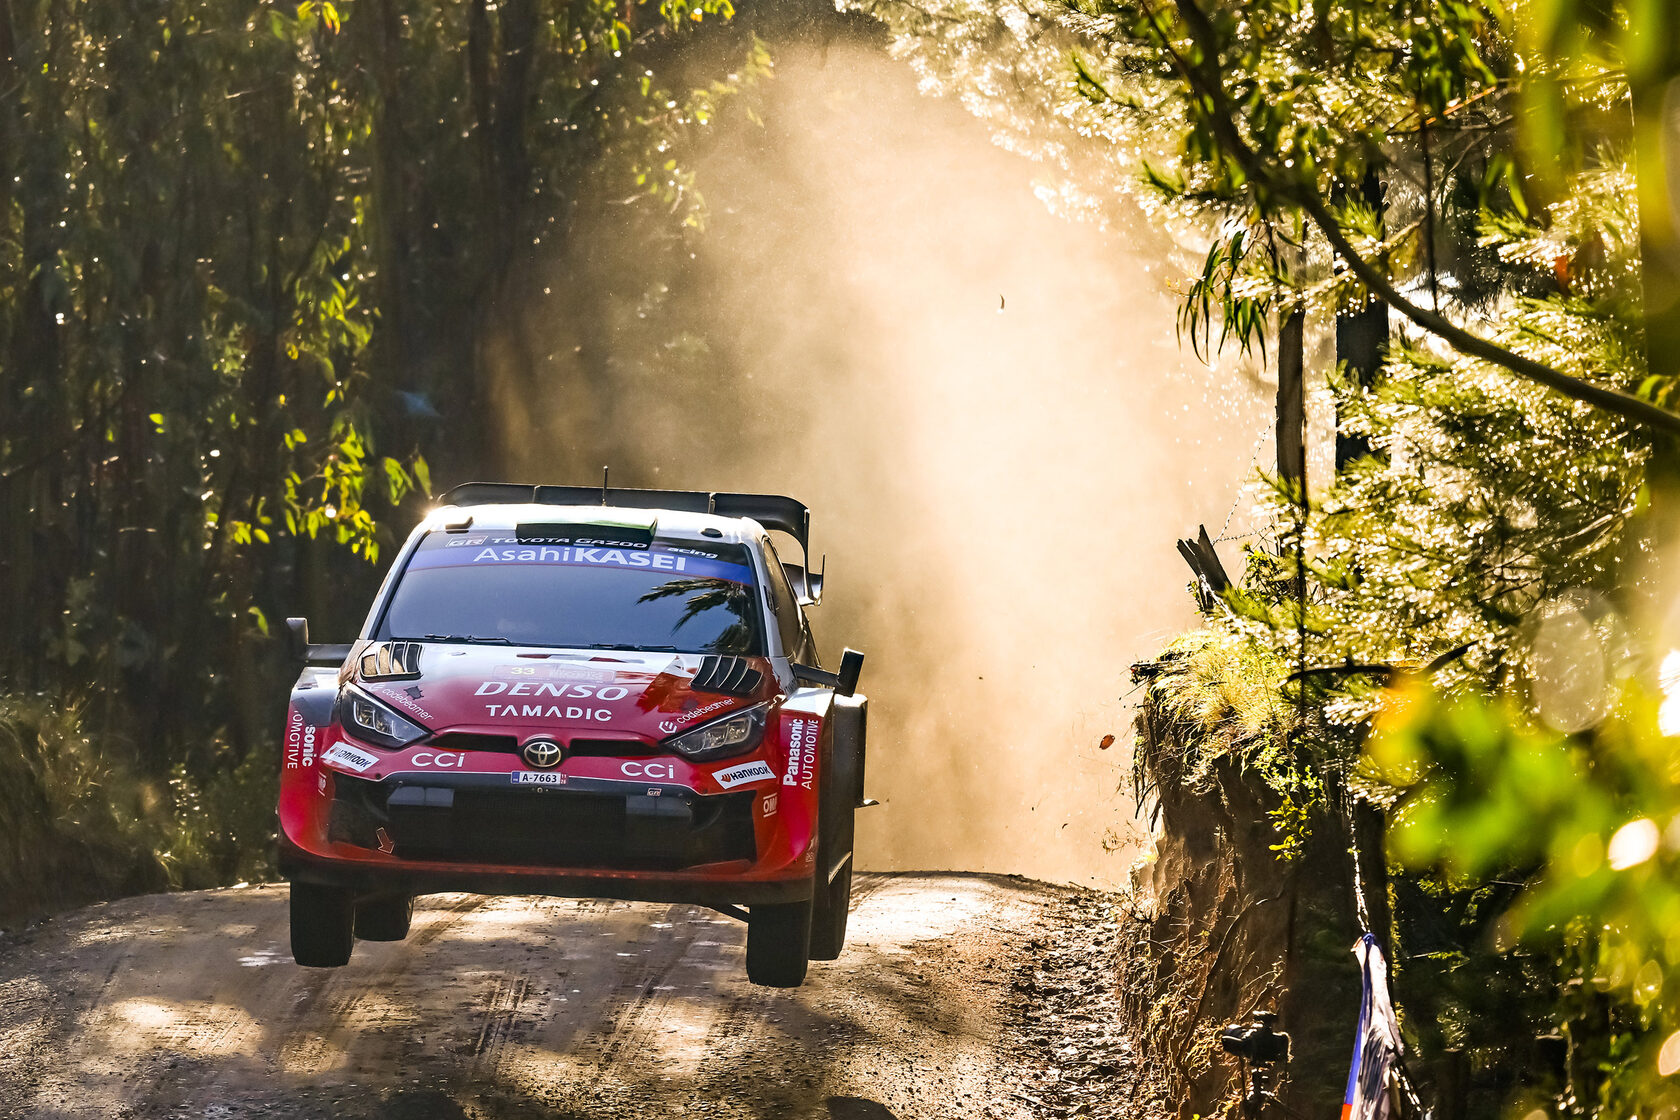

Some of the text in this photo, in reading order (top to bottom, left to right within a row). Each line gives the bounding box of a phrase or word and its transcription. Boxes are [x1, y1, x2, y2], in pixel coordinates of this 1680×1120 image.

[575, 538, 648, 548] GAZOO
[666, 547, 719, 559] acing
[511, 667, 536, 675] 33
[474, 681, 629, 701] DENSO
[382, 688, 433, 721] codebeamer
[485, 704, 613, 722] TAMADIC
[676, 698, 735, 724] codebeamer
[287, 710, 303, 769] OMOTIVE
[302, 725, 317, 767] sonic
[783, 718, 804, 786] Panasonic
[801, 719, 819, 790] AUTOMOTIVE
[522, 773, 557, 783] A-7663
